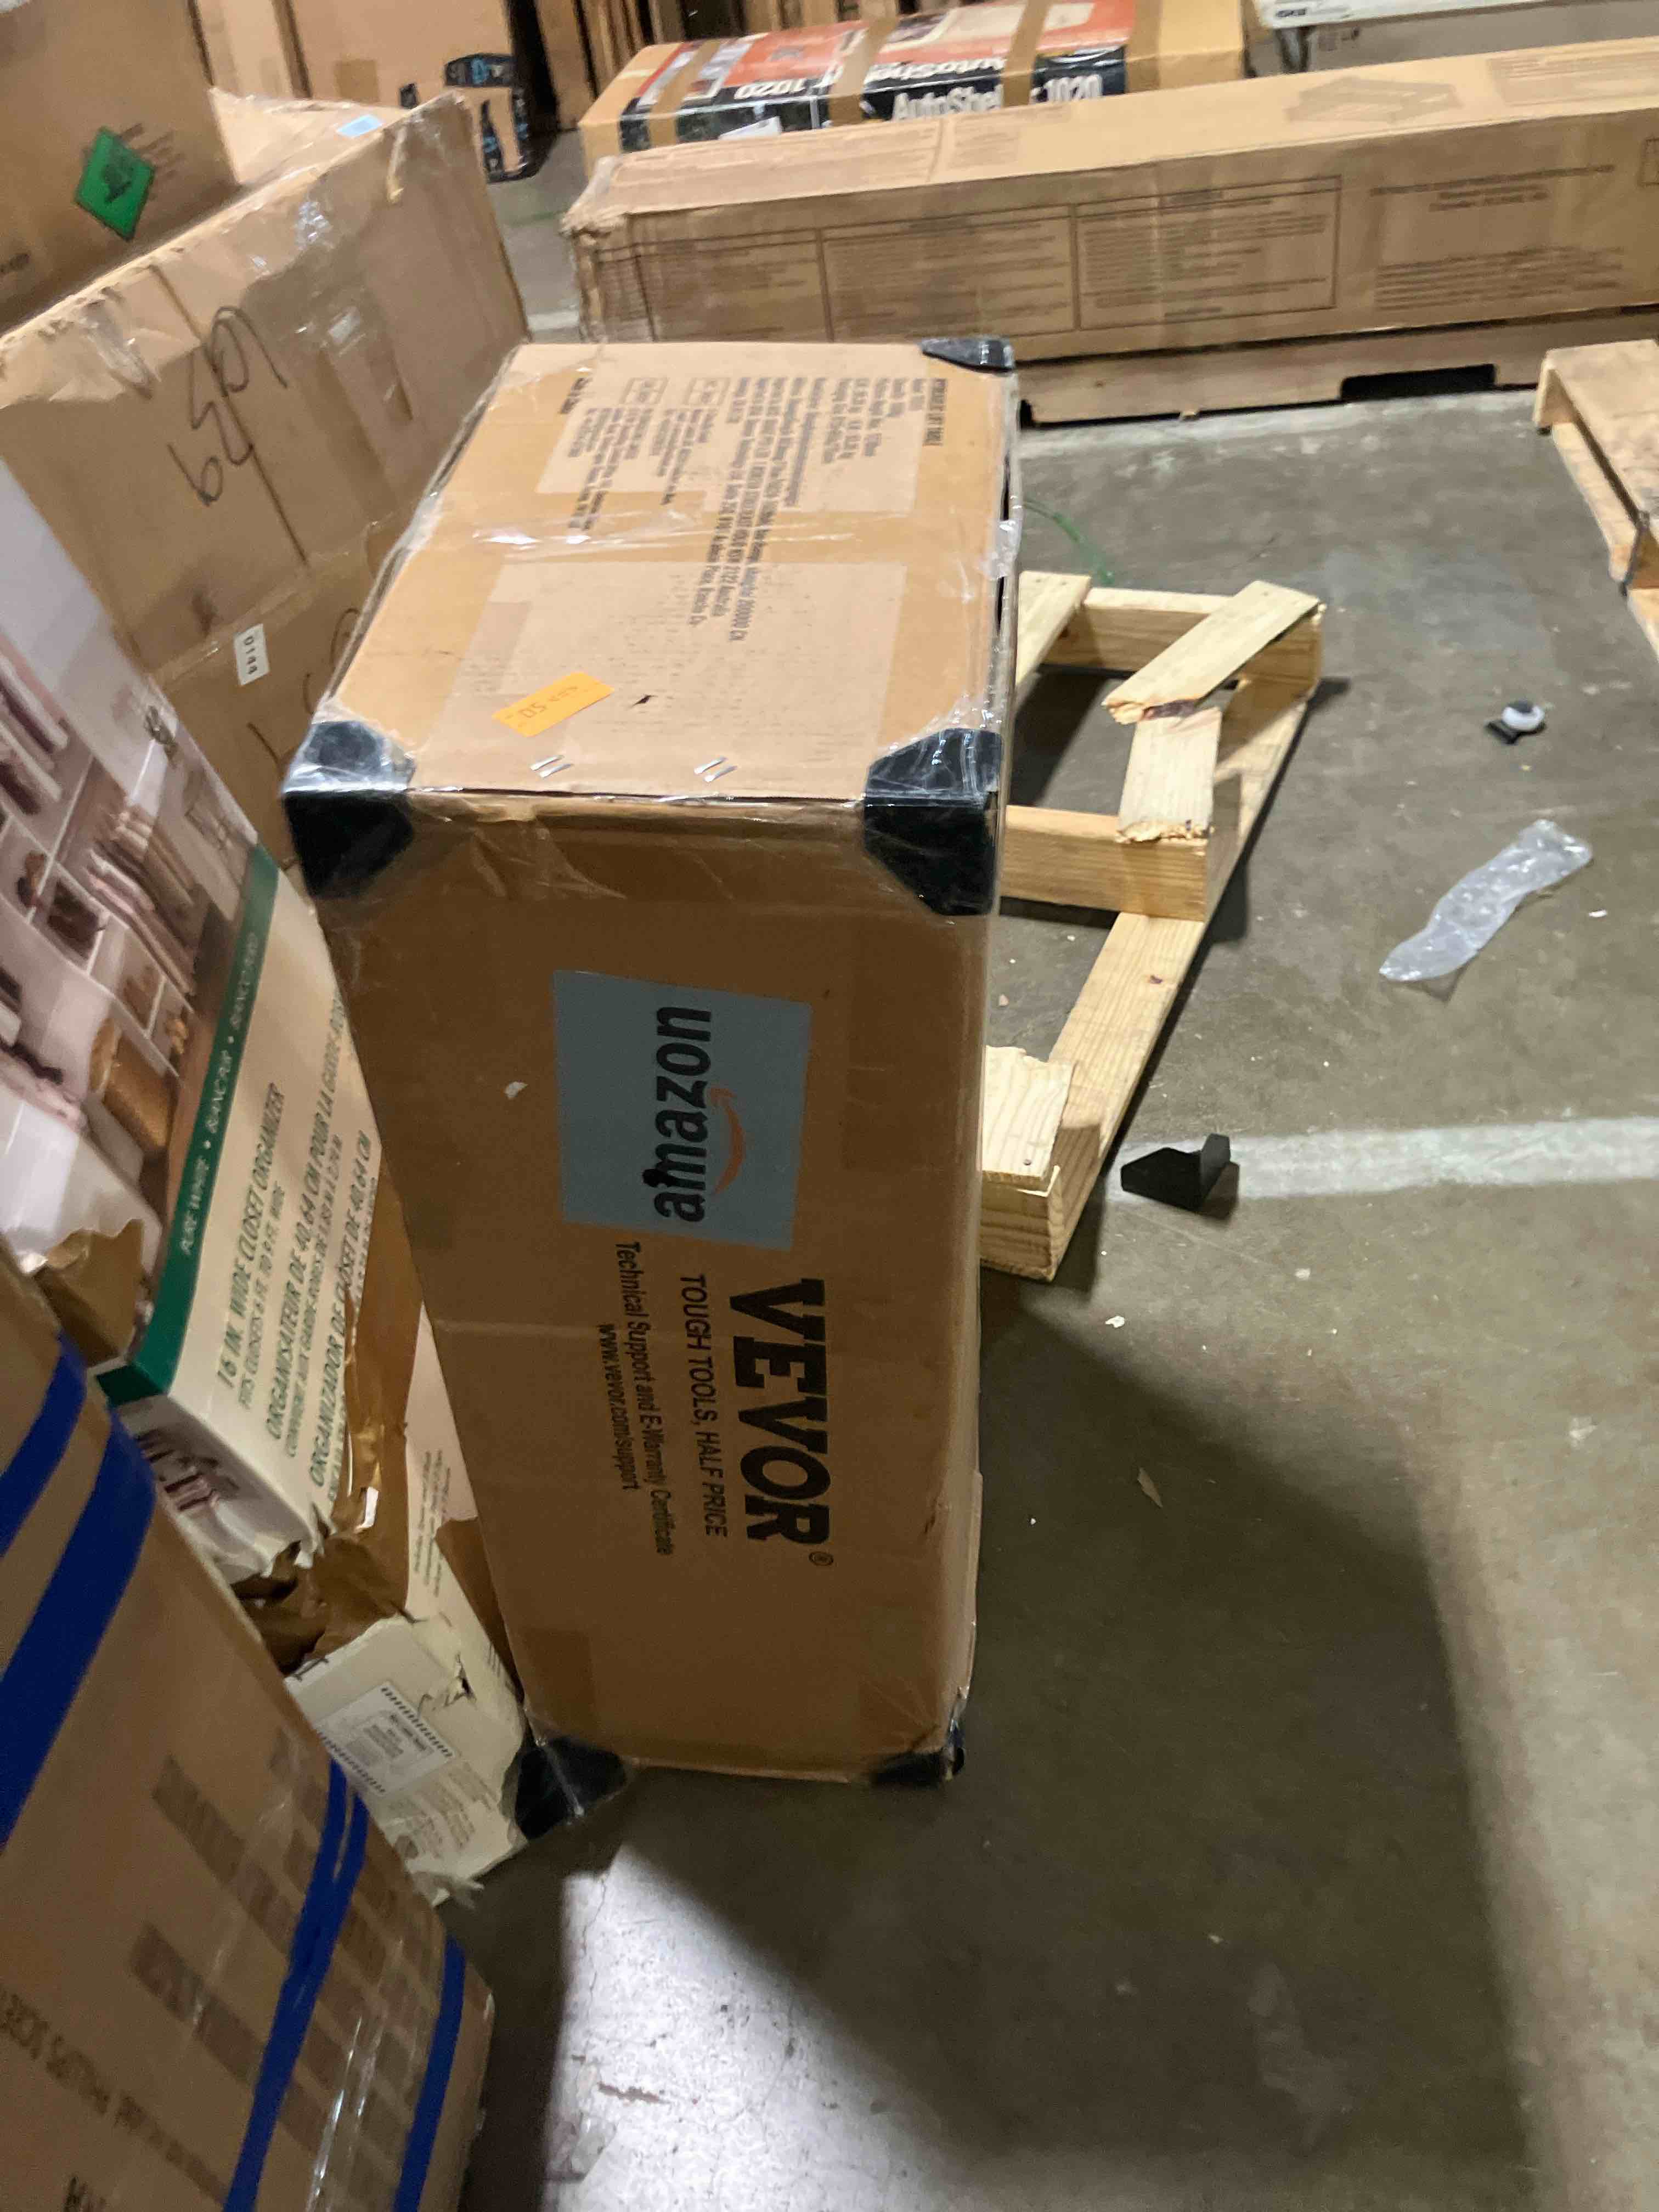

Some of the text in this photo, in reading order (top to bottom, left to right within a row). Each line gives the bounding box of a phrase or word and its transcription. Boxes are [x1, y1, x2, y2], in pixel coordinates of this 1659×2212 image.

[253, 1082, 283, 1190] ORGANIZER
[654, 1007, 712, 1222] amazon
[238, 1184, 263, 1262] CLOSET
[228, 1258, 251, 1319] WIDE
[614, 1242, 650, 1317] Technical
[217, 1355, 237, 1390] 16
[265, 1280, 302, 1440] ORGANISATEUR
[624, 1321, 656, 1381] Support
[635, 1384, 661, 1410] and
[680, 1273, 729, 1537] TOUGH TOOLS, HALF PRICE
[730, 1278, 831, 1544] VEVOR
